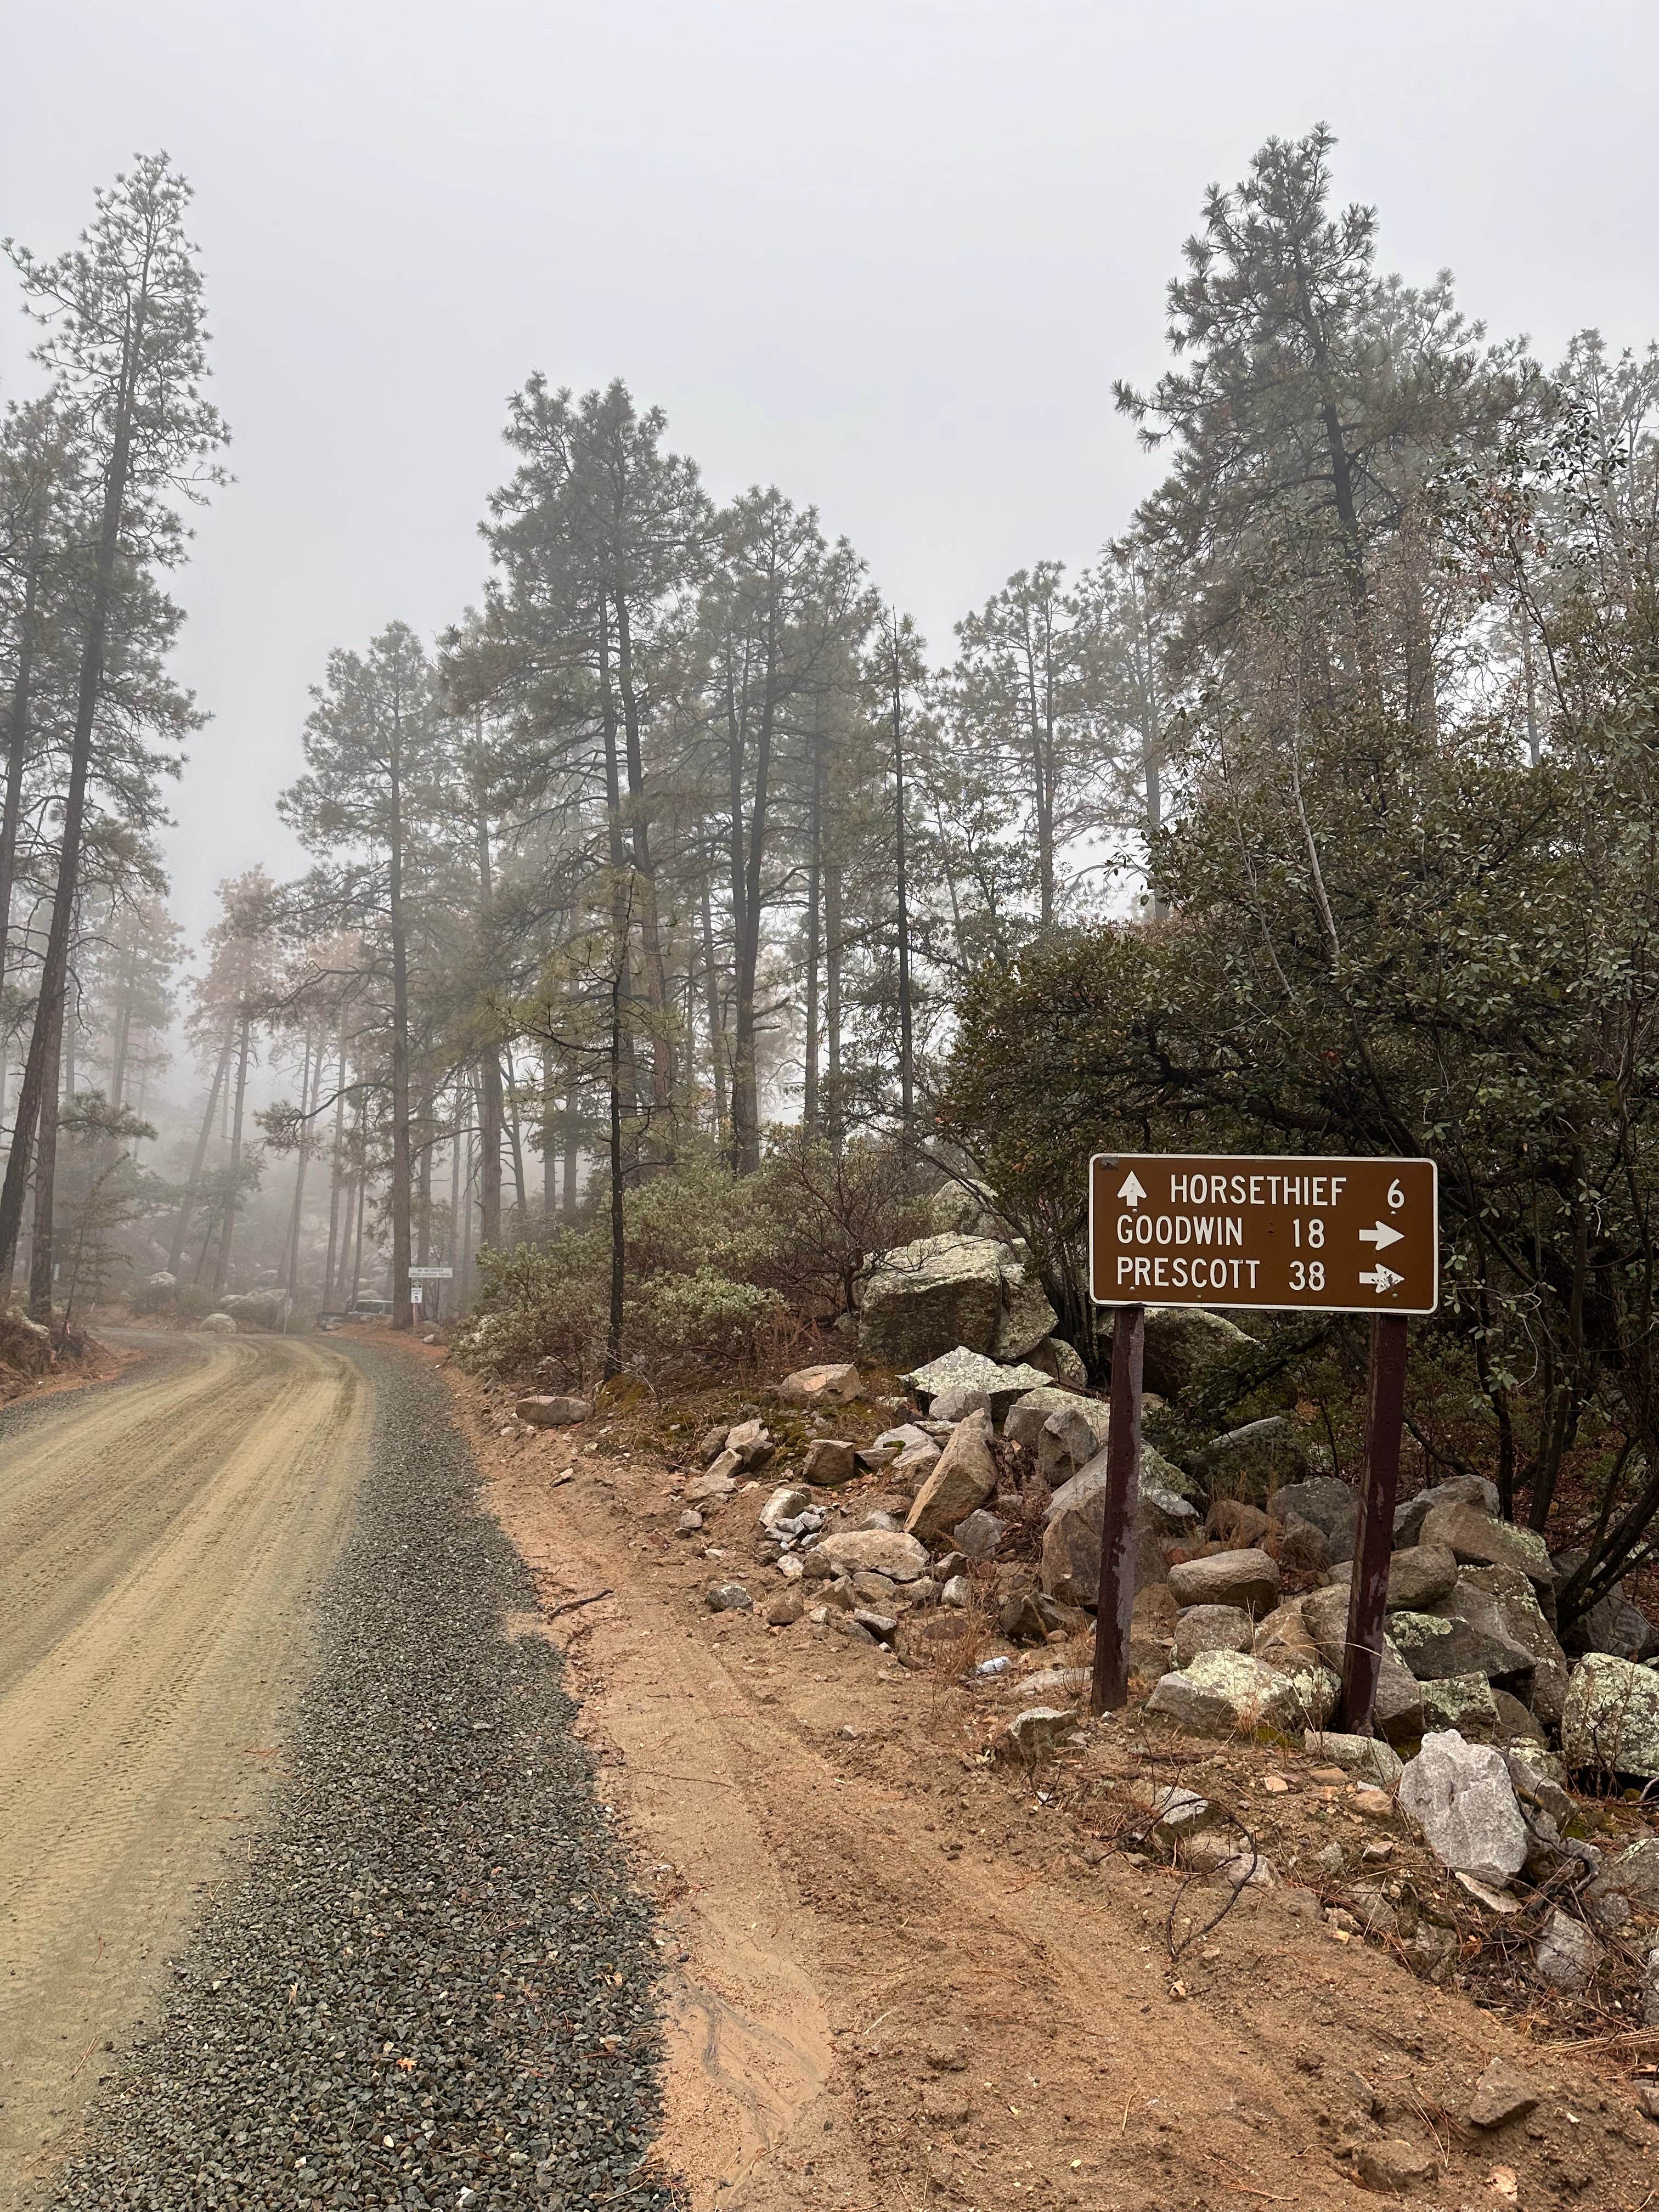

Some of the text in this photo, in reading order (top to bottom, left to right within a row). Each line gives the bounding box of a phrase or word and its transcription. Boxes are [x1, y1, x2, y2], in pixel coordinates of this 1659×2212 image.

[1171, 1174, 1405, 1208] HORSETHIEF 6
[1117, 1214, 1325, 1248] GOODWIN 18
[1117, 1256, 1325, 1291] PRESCOTT 38
